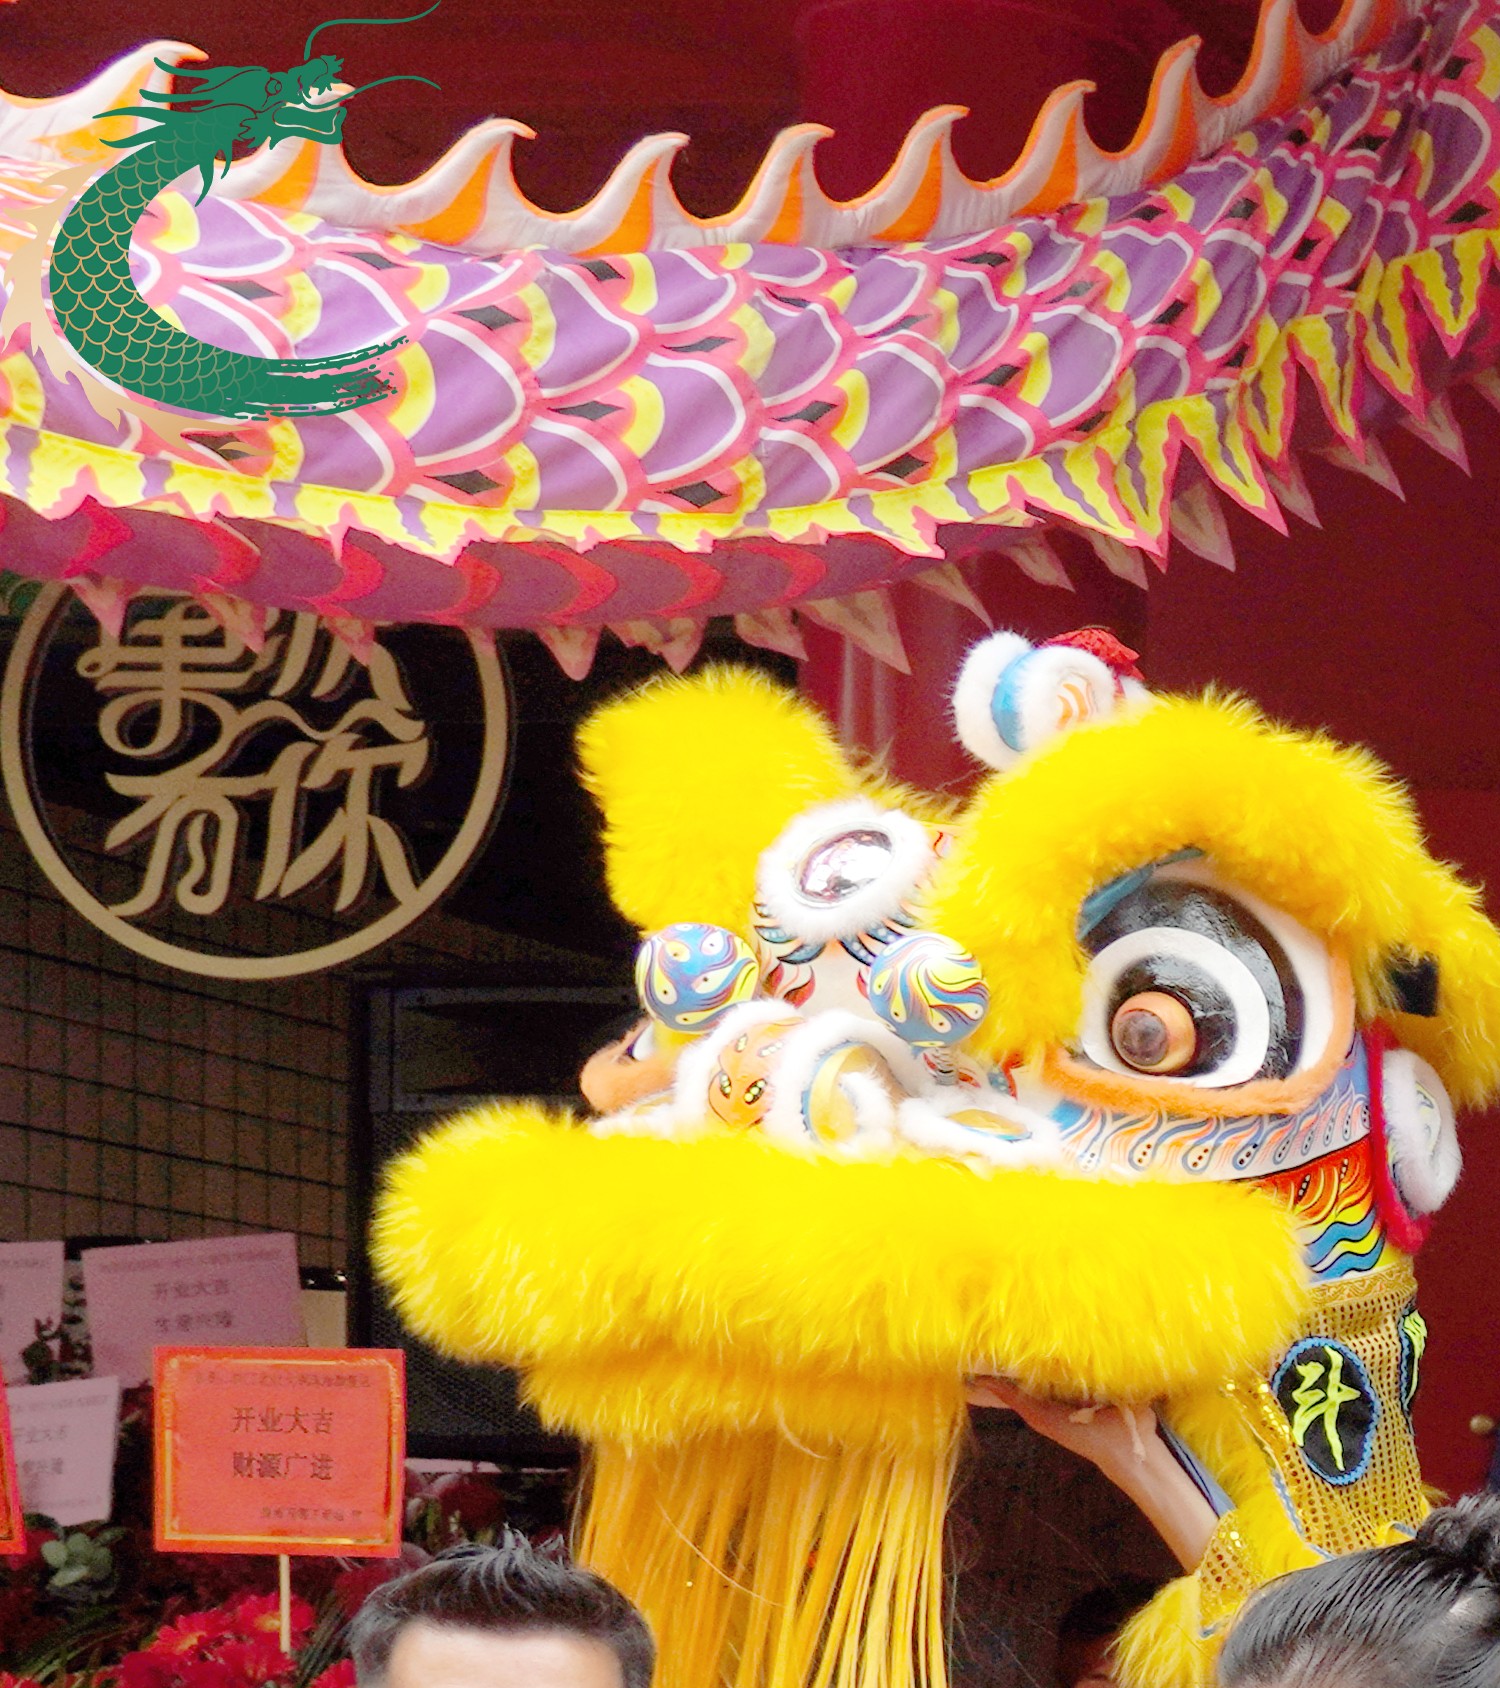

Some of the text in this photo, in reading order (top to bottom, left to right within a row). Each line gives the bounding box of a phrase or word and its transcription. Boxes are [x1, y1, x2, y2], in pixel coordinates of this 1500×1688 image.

[230, 1406, 335, 1435] 开业大吉
[230, 1450, 335, 1481] 财源广进
